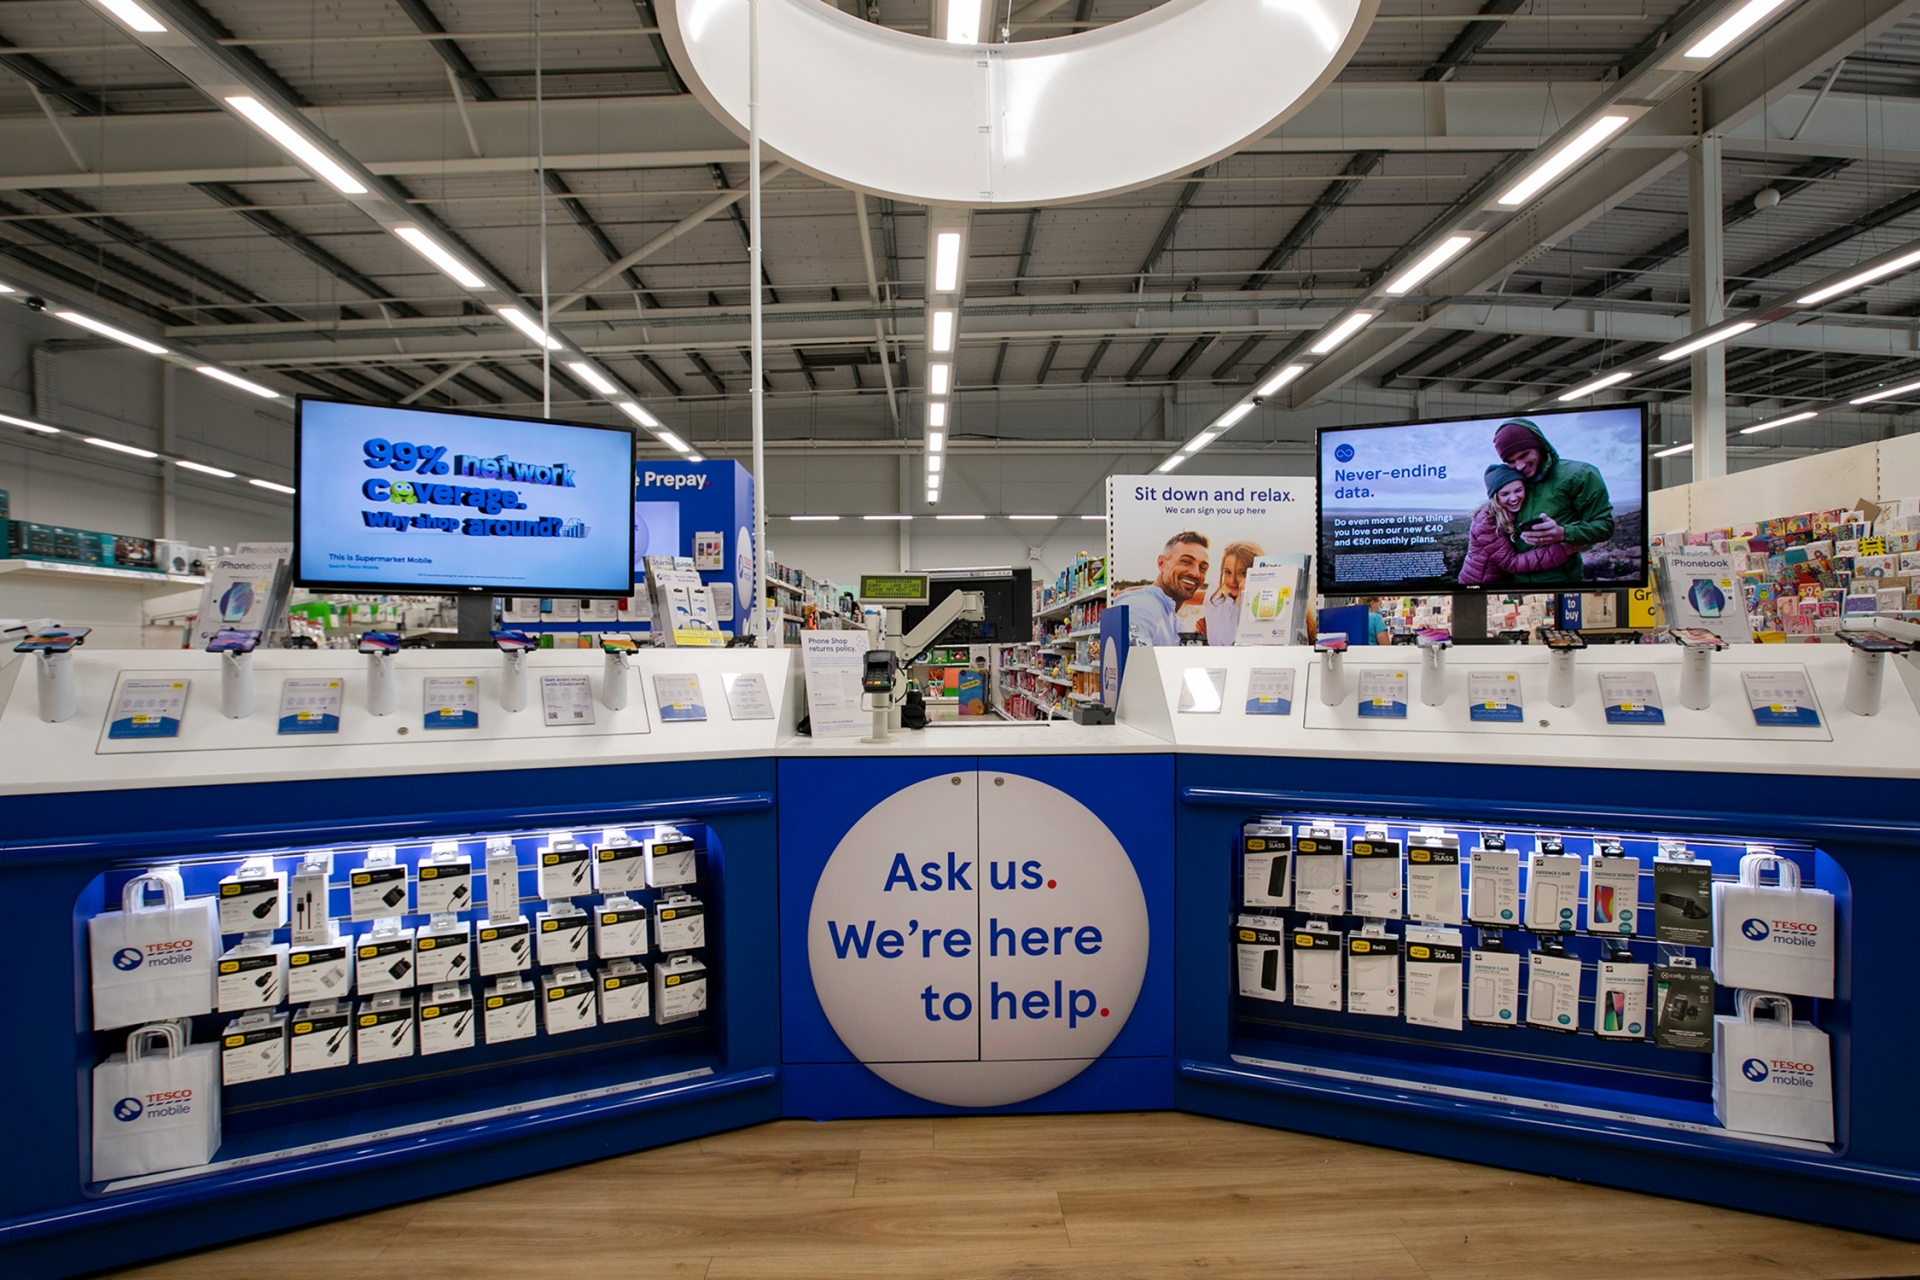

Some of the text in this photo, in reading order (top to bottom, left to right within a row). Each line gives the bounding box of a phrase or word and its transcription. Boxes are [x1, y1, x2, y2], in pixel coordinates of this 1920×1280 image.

[363, 437, 576, 488] 99% network
[1334, 463, 1447, 482] Never-ending
[644, 471, 710, 490] Prepay.
[1134, 486, 1296, 502] Sit down and relax.
[1334, 485, 1375, 499] data.
[1165, 506, 1178, 514] We
[1197, 506, 1215, 516] sign
[1216, 508, 1232, 516] you
[1233, 508, 1245, 516] up
[1246, 507, 1266, 515] here
[361, 511, 563, 538] Why shop around?
[1334, 513, 1453, 526] Do even more of the things
[1334, 528, 1350, 537] you
[1352, 526, 1371, 536] love
[1385, 526, 1401, 534] our
[1403, 525, 1423, 533] new
[1424, 524, 1444, 533] €40
[1334, 534, 1438, 548] and €50 monthly plans.
[329, 553, 345, 561] This
[355, 554, 405, 563] Supermarket
[407, 556, 433, 564] Mobile
[652, 559, 672, 567] Starte
[1674, 559, 1729, 567] Phonebook
[222, 561, 273, 570] Phonebook
[1567, 599, 1576, 609] to
[1565, 609, 1579, 622] buy
[831, 637, 848, 645] Shop
[835, 645, 857, 653] policy.
[883, 851, 1057, 892] Ask us.
[1772, 920, 1817, 932] TESCO
[827, 918, 1102, 959] We're here
[1773, 934, 1816, 948] mobile
[146, 939, 193, 952] TESCO
[148, 953, 192, 968] mobile
[920, 980, 1110, 1029] to help.
[1770, 1060, 1814, 1072] TESCO
[1772, 1075, 1813, 1088] mobile
[146, 1088, 192, 1102] TESCO
[147, 1104, 191, 1118] mobile
